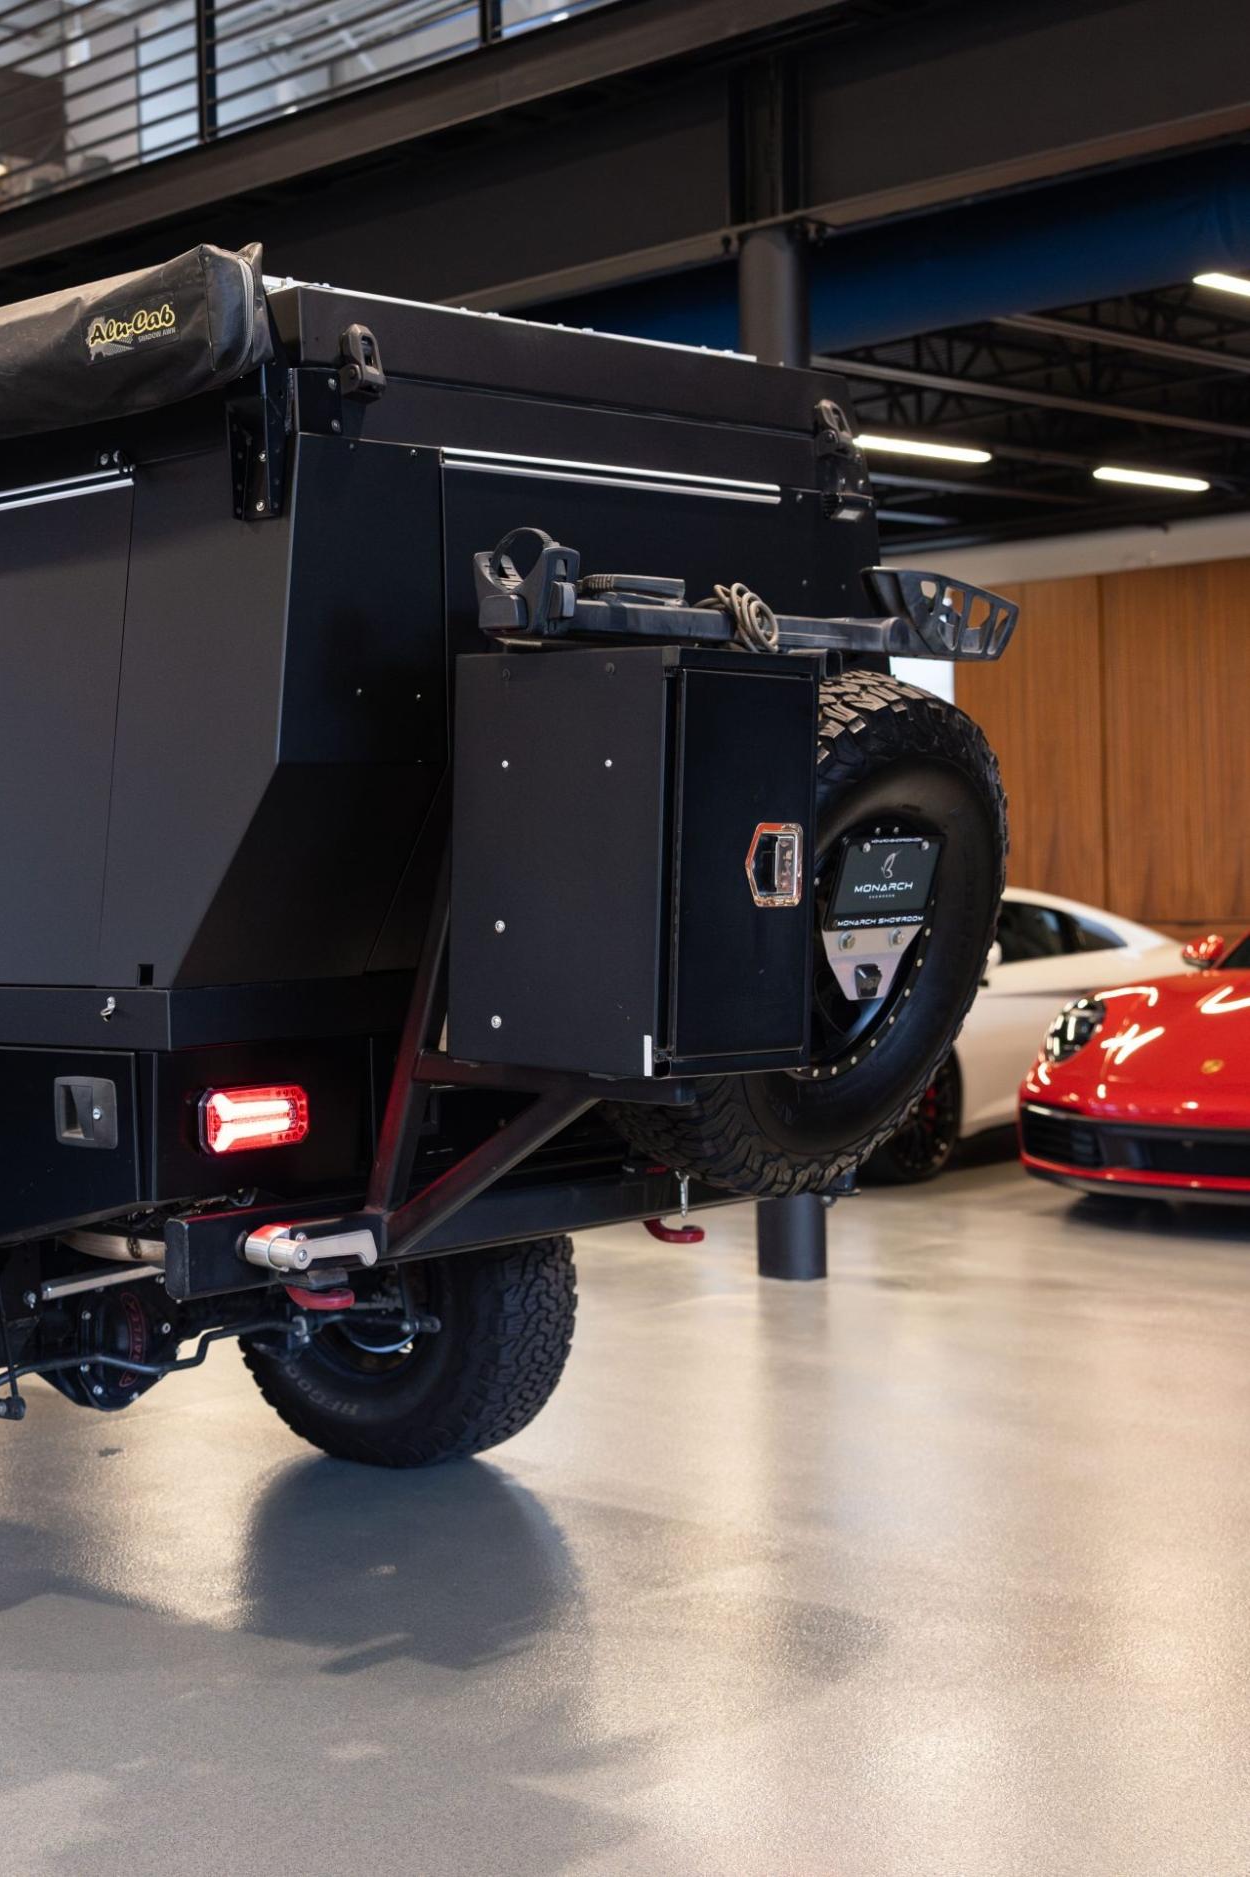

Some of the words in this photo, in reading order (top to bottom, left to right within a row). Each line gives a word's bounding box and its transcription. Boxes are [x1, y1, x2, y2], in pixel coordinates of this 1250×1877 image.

[89, 304, 175, 347] Alu-Cab
[854, 881, 913, 893] MONARCH
[837, 918, 876, 927] MONARCH
[877, 915, 924, 925] SHOWROOM
